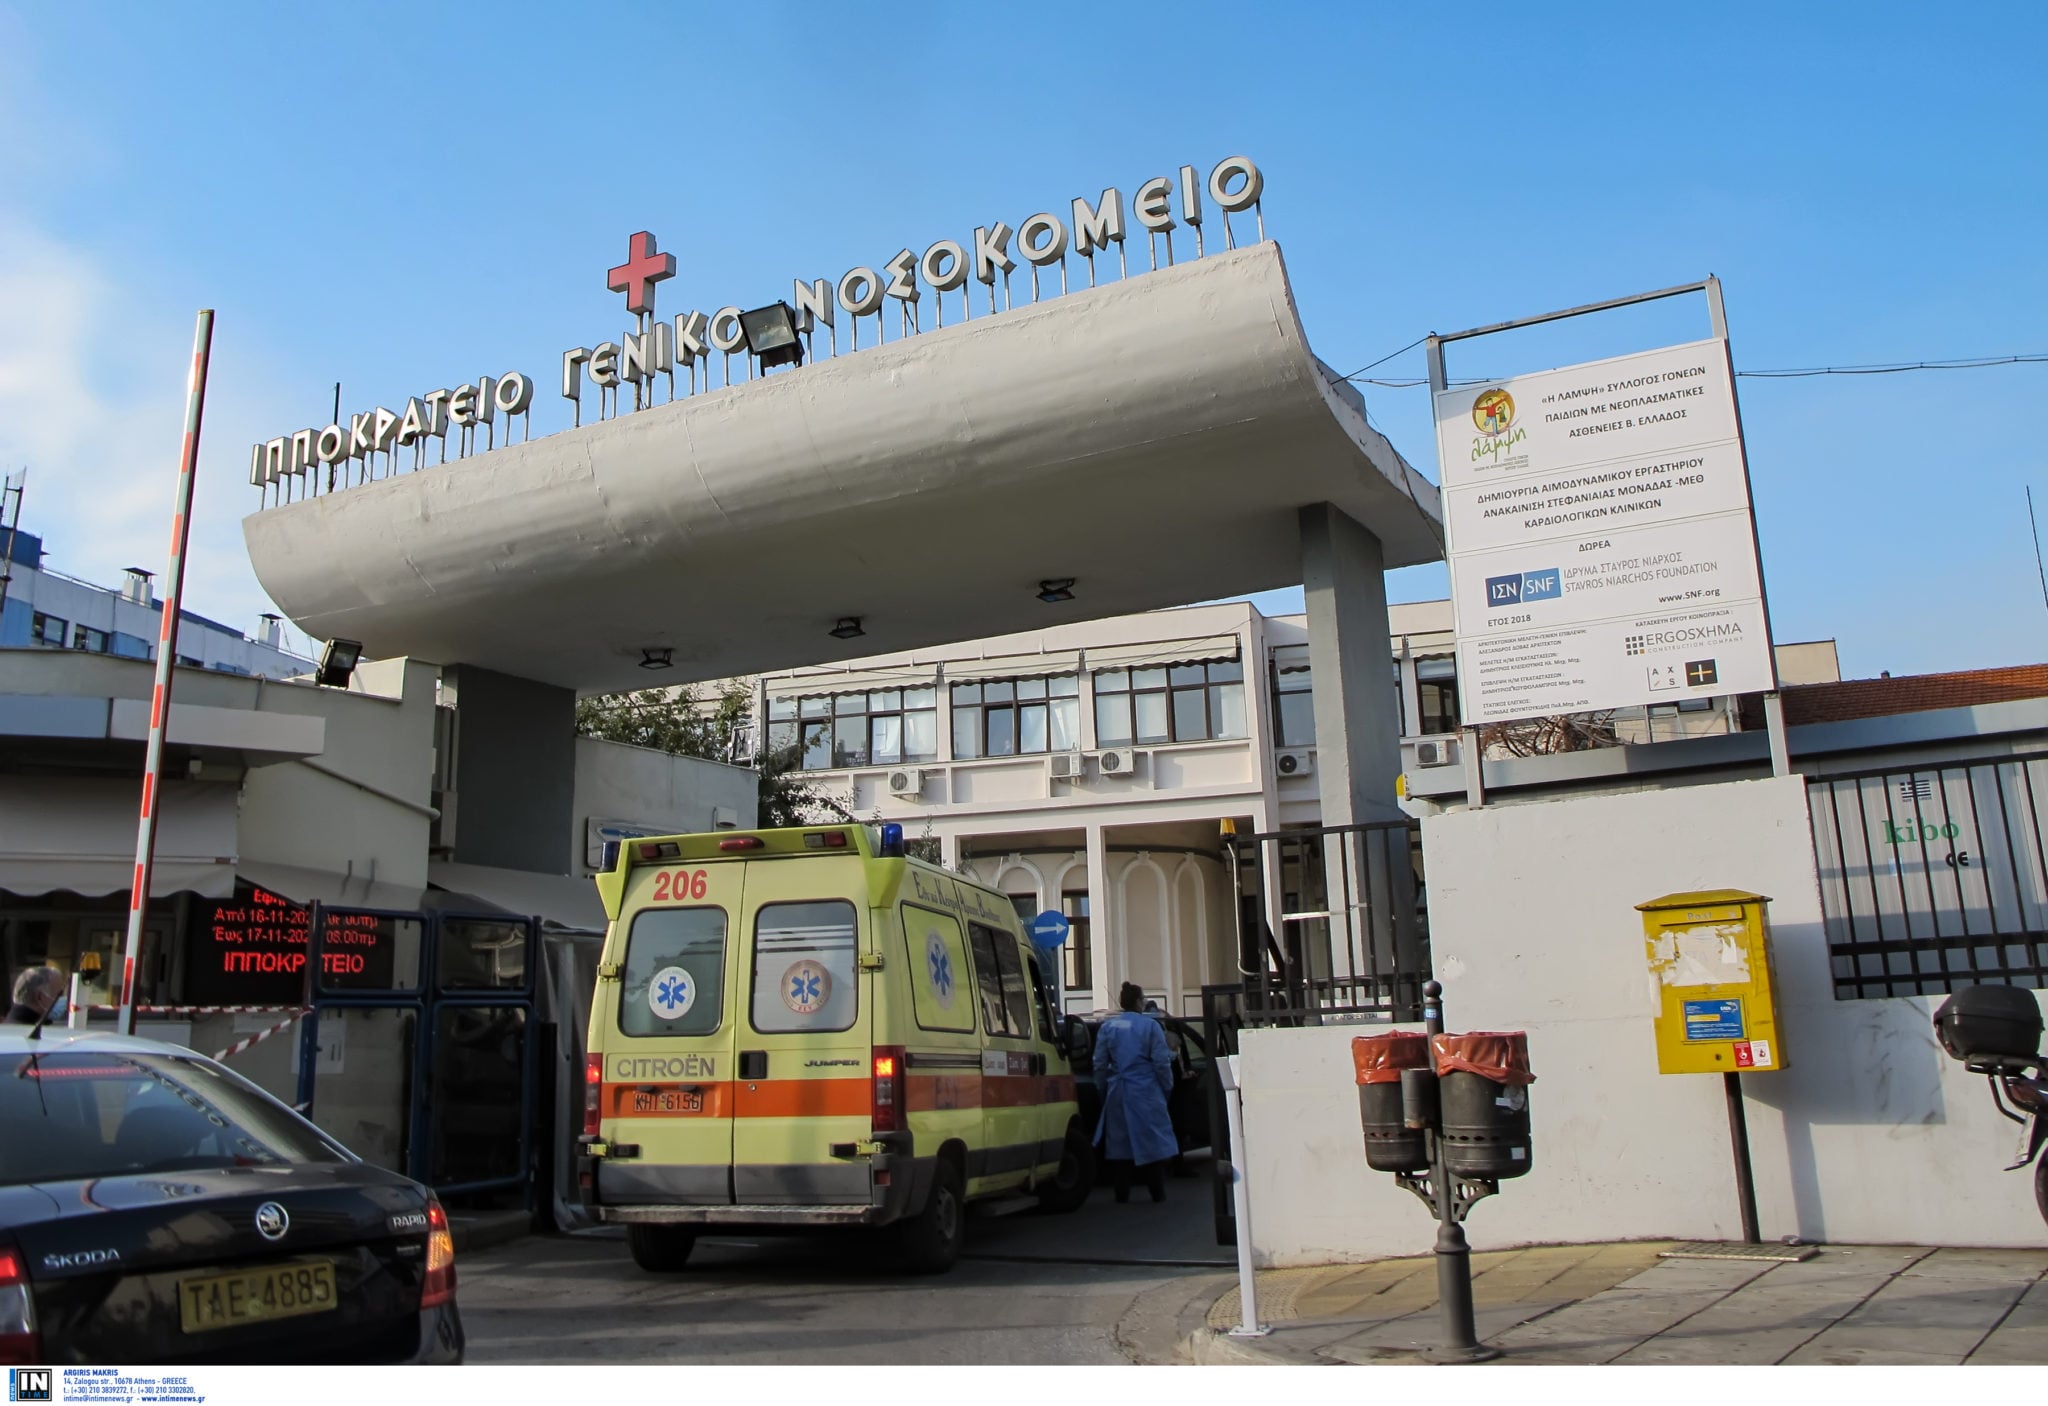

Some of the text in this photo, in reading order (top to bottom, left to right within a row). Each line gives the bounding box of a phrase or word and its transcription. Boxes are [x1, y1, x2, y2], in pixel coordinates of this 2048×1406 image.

[250, 155, 1264, 487] ΙΠΠΟΚΡΑΤΕΙΟ ΓΕΝΙΚΟ ΝΟΣΟΚΟΜΕΙΟ
[1557, 387, 1605, 401] ΛΑΜΨΗ»
[1607, 374, 1660, 393] ΣΥΛΛΟΓΟΣ
[1662, 366, 1706, 382] ΓΟΝΕΩΝ
[1545, 386, 1705, 423] ΠΑΙΔΙΩΝ ΜΕ ΝΕΟΠΛΑΣΜΑΤΙΚΕΣ
[1568, 409, 1688, 438] ΑΣΘΕΝΕΙΕΣ Β. ΕΛΛΑΔΟΣ
[1477, 457, 1704, 504] ΔΗΜΙΟΥΡΓΙΑ ΑΙΜΟΔΥΝΑΜΙΚΟΥ ΕΡΓΑΣΤΗΡΙΟΥ
[1483, 474, 1705, 519] ΑΝΑΚΑΙΝΙΣΗ ΣΤΕΦΑΝΙΑΙΑΣ ΜΟΝΑΔΑΣ -ΜΕΘ
[1524, 499, 1662, 529] ΚΑΡΔΙΟΛΟΓΙΚΩΝ ΚΛΙΝΙΚΩΝ
[1578, 540, 1611, 552] ΔΩΡΕΑ
[1563, 551, 1682, 579] ΙΔΡΥΜΑ ΣΤΑΥΡΟΣ ΝΙΑΡΧΟΣ
[1527, 577, 1555, 594] SNF
[1565, 561, 1718, 593] STAVROS NIARCHOS FOUNDATION
[1492, 582, 1517, 599] ΙΣΝ
[1658, 588, 1721, 603] www.SNF.org
[1487, 614, 1532, 627] ΕΤΟΣ 2018
[1635, 617, 1669, 627] ΚΑΤΑΣΚΕΥΗ
[1646, 622, 1743, 645] ERGOSXHMA
[1647, 636, 1743, 654] CONSTRUCTION COMPANY
[653, 869, 708, 901] 206
[214, 907, 246, 922] Από
[247, 927, 310, 943] 17-11-202
[224, 951, 364, 974] ΙΠΠΟΚΡΤΕΙΟ
[616, 1053, 716, 1078] CITROËN
[803, 1058, 860, 1067] JUMPER
[392, 1214, 427, 1228] RAPID
